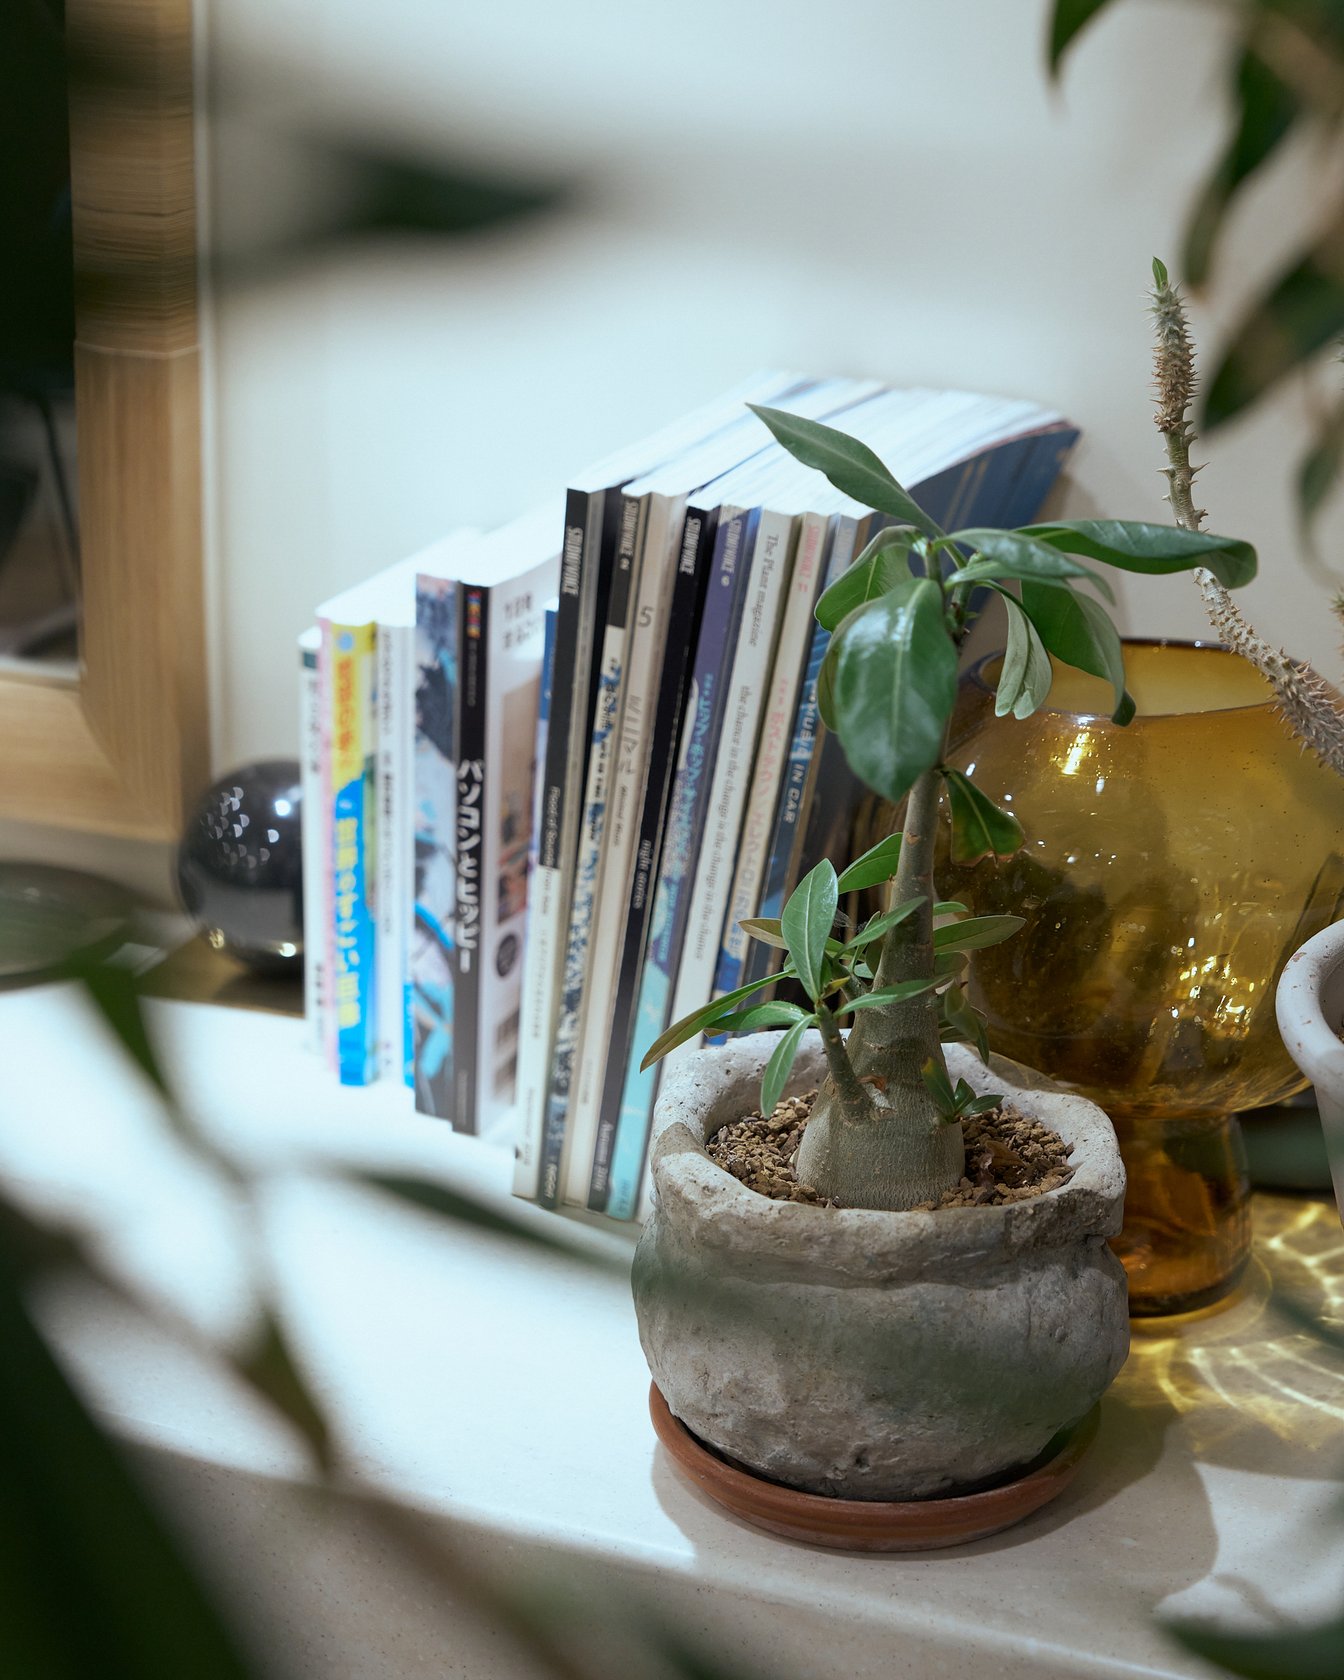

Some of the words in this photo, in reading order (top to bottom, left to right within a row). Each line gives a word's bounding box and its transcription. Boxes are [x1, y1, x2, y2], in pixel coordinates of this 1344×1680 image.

[764, 533, 780, 556] The
[760, 556, 776, 589] Plant
[638, 605, 654, 628] 5
[750, 589, 769, 647] magazine
[791, 764, 805, 784] IN
[784, 787, 801, 824] CAR
[456, 759, 484, 974] パソコンとヒッピー
[637, 839, 652, 871] night
[632, 870, 650, 910] stories
